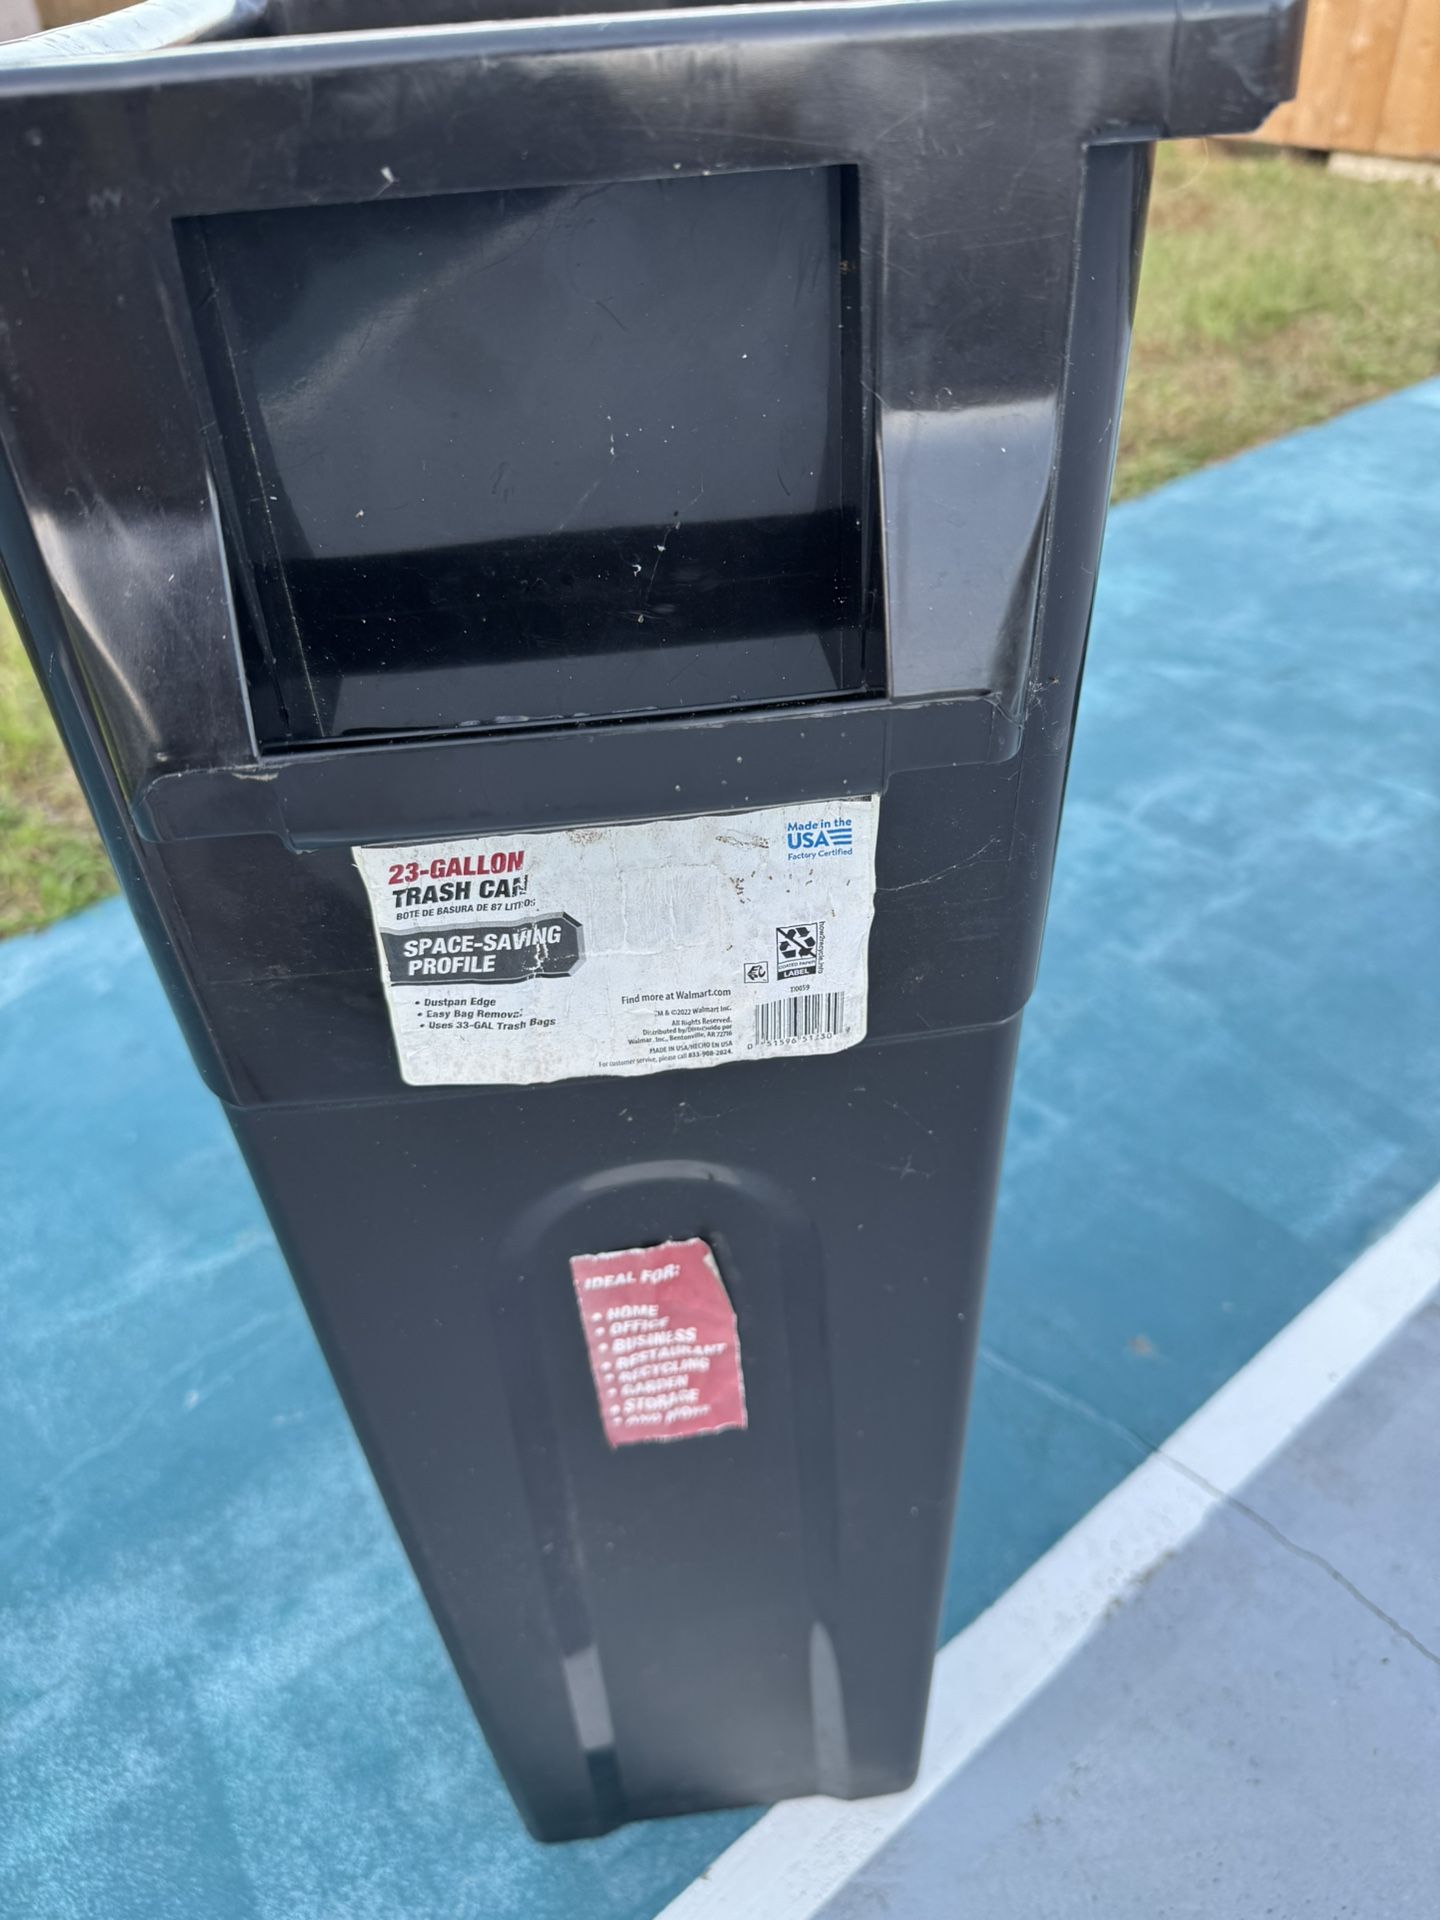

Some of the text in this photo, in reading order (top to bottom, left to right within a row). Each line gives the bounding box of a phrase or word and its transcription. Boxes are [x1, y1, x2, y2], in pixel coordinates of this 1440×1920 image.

[788, 817, 852, 831] Made in the
[788, 830, 829, 849] USA
[788, 847, 853, 860] Factory Certified
[388, 851, 525, 885] 23-GALLON
[392, 881, 471, 908] TRASH
[396, 912, 420, 921] BOTE
[422, 909, 434, 917] DE
[437, 905, 474, 915] BASURA
[476, 903, 488, 912] DE
[490, 903, 502, 911] 87
[404, 925, 562, 958] SPACE-SAVING
[408, 954, 496, 976] PROFILE
[783, 968, 810, 978] LABEL
[424, 997, 496, 1008] Dustpan Edge
[621, 988, 731, 1005] Find more at Walmart.com
[426, 1009, 450, 1019] Easy
[454, 1009, 474, 1019] Bag
[693, 1006, 719, 1014] Walmart
[428, 1017, 556, 1030] Uses 33-GAL Trash Bags
[681, 1019, 701, 1027] Rights
[702, 1016, 732, 1025] Reserved.
[669, 1031, 706, 1041] Bentonville,
[649, 1046, 667, 1054] MADE
[676, 1042, 711, 1052] USA/HECHO
[584, 1264, 681, 1290] IDEAL FOR:
[606, 1305, 659, 1320] HOME
[609, 1317, 669, 1334] OFFICE
[612, 1327, 697, 1352] BUSINESS
